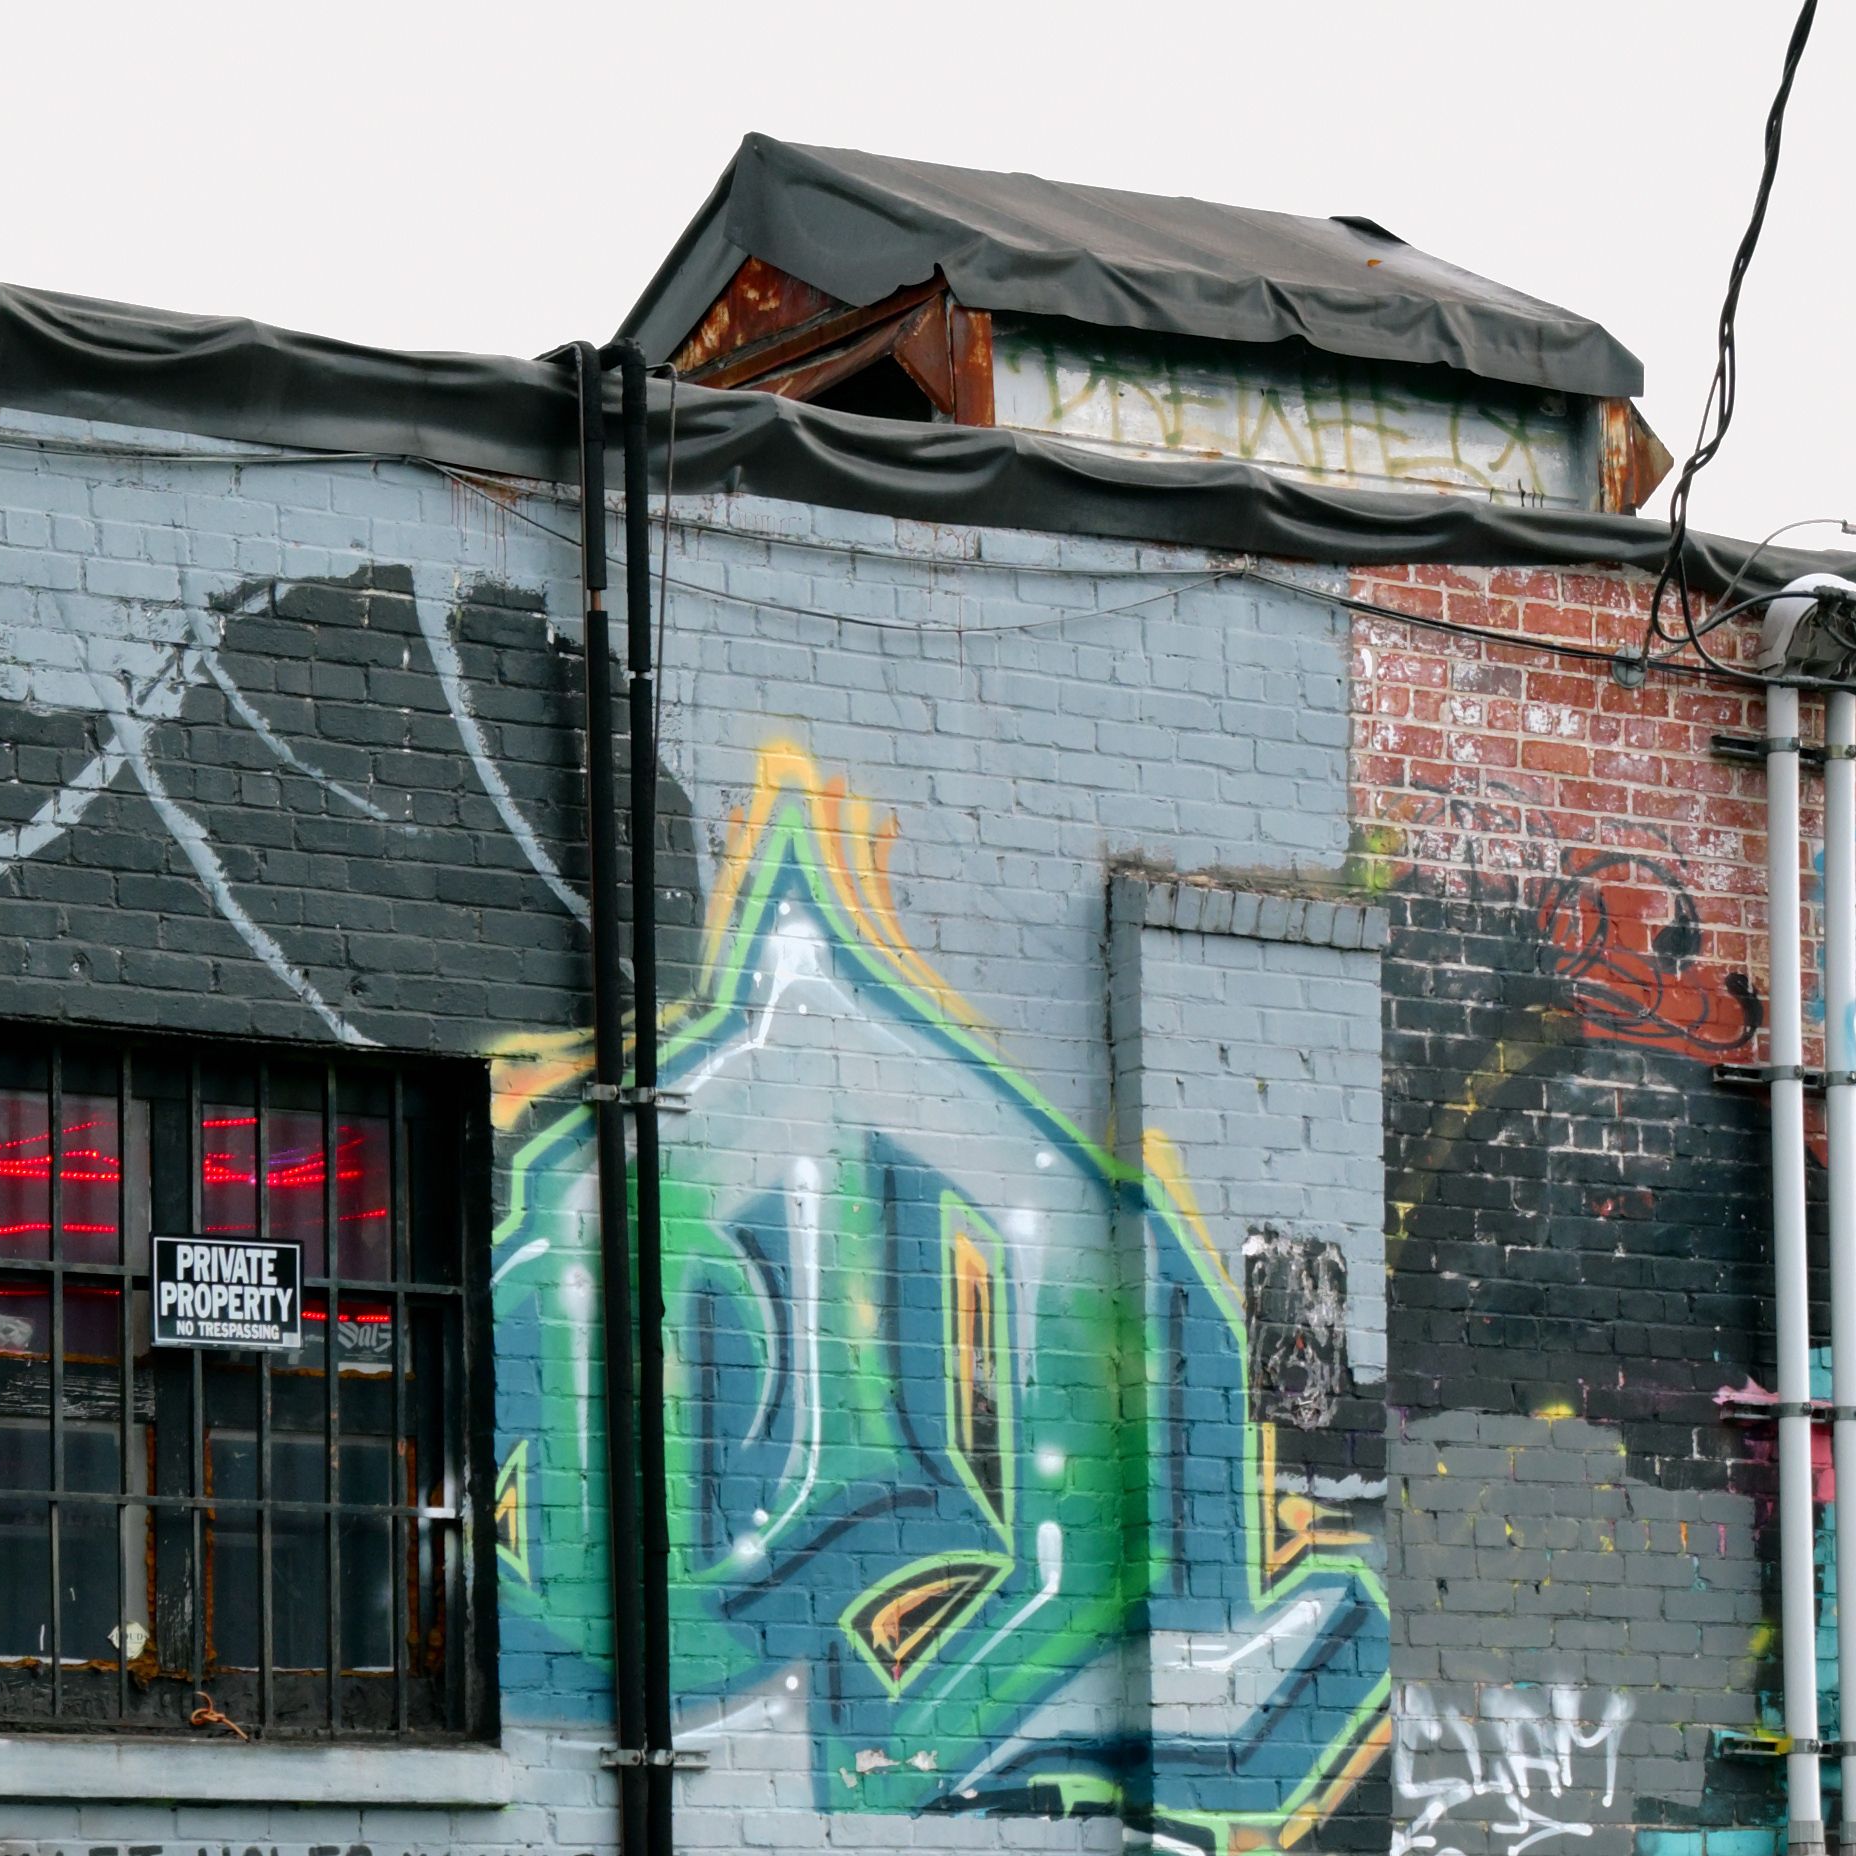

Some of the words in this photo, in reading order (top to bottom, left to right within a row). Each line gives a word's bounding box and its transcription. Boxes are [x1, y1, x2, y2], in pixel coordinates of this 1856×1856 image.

[176, 1244, 277, 1286] PRIVATE
[160, 1281, 293, 1323] PROPERTY
[176, 1320, 194, 1336] NO
[198, 1321, 280, 1340] TRESPASSING
